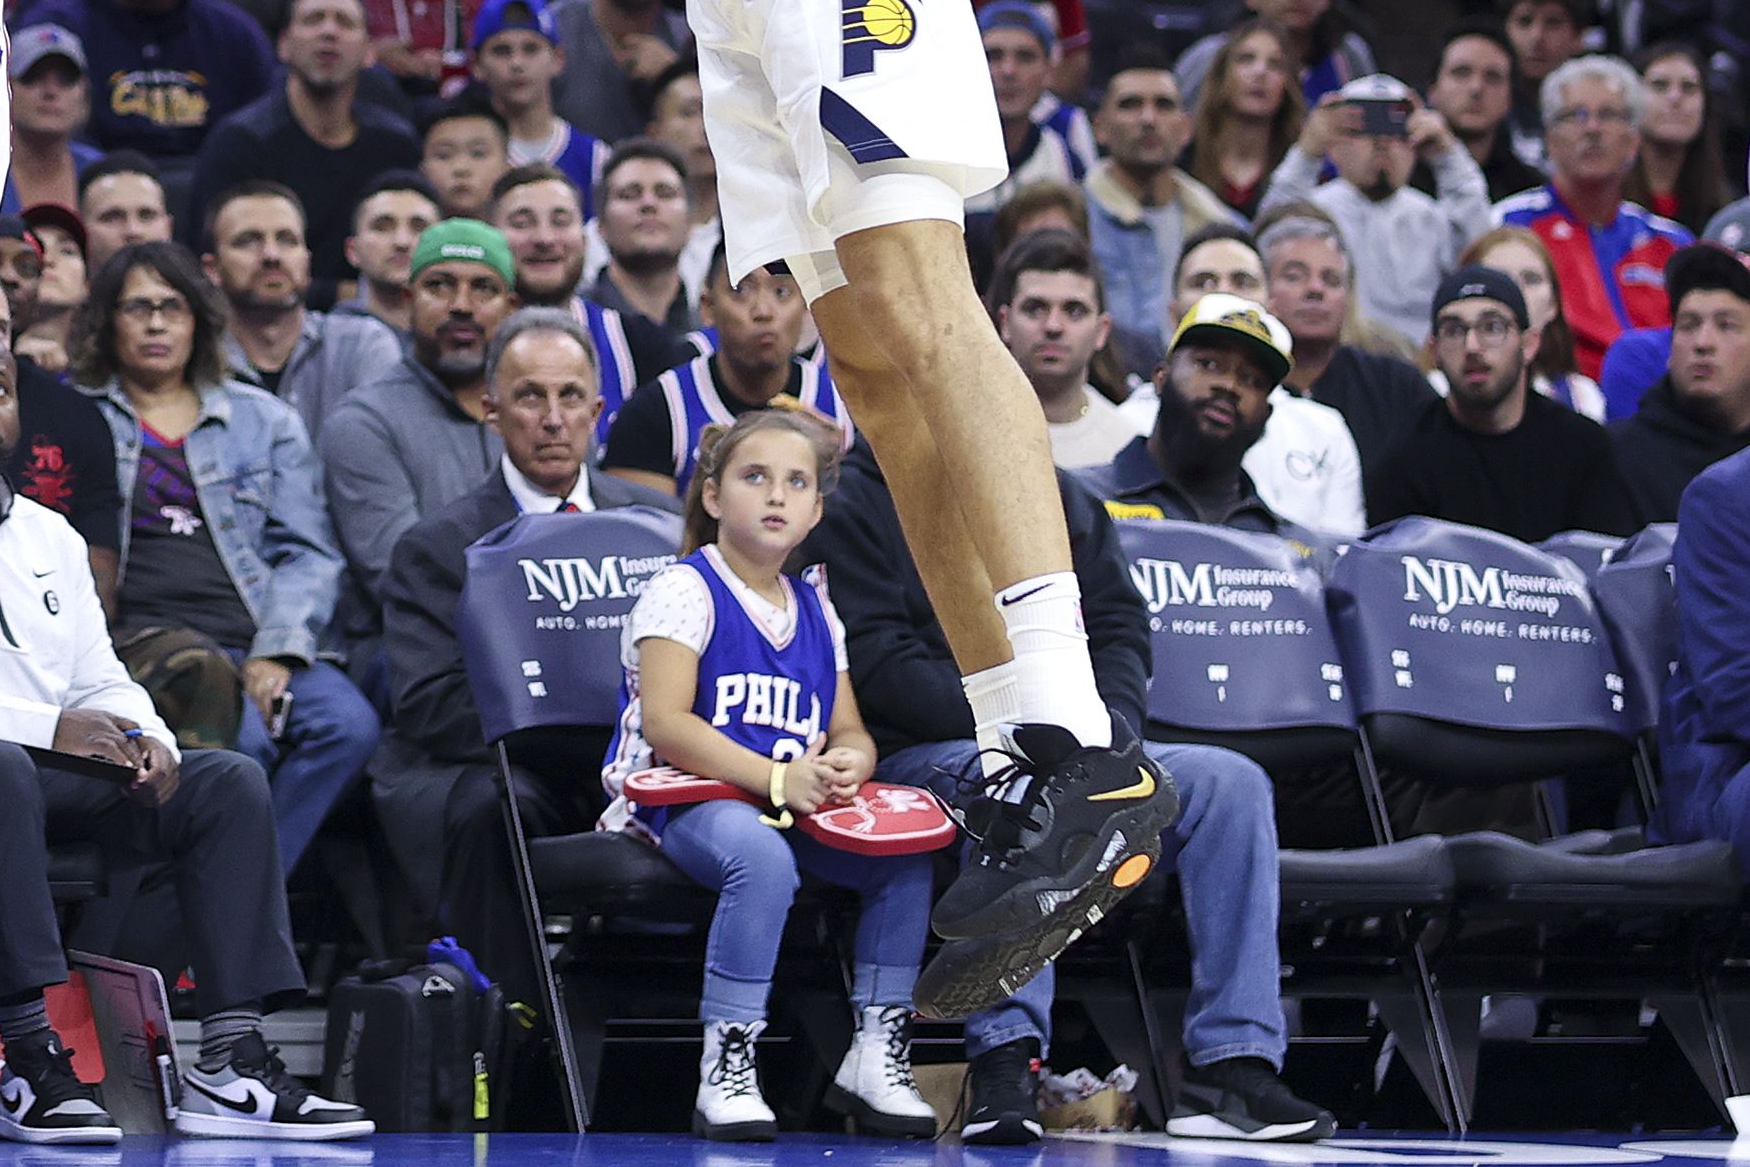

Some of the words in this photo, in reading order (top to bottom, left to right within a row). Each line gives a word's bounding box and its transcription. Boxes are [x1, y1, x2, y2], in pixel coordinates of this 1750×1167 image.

[32, 445, 64, 470] 76
[517, 555, 627, 612] NJM
[1129, 557, 1218, 613] NJM
[1401, 555, 1506, 614] NJM
[1216, 586, 1273, 611] Group
[1504, 590, 1560, 618] Group
[536, 616, 581, 630] AUTO.
[1171, 619, 1225, 635] HOME.
[1229, 620, 1314, 635] RENTERS.
[1409, 613, 1456, 633] AUTO.
[1461, 619, 1513, 638] HOME.
[1518, 624, 1597, 644] RENTERS.
